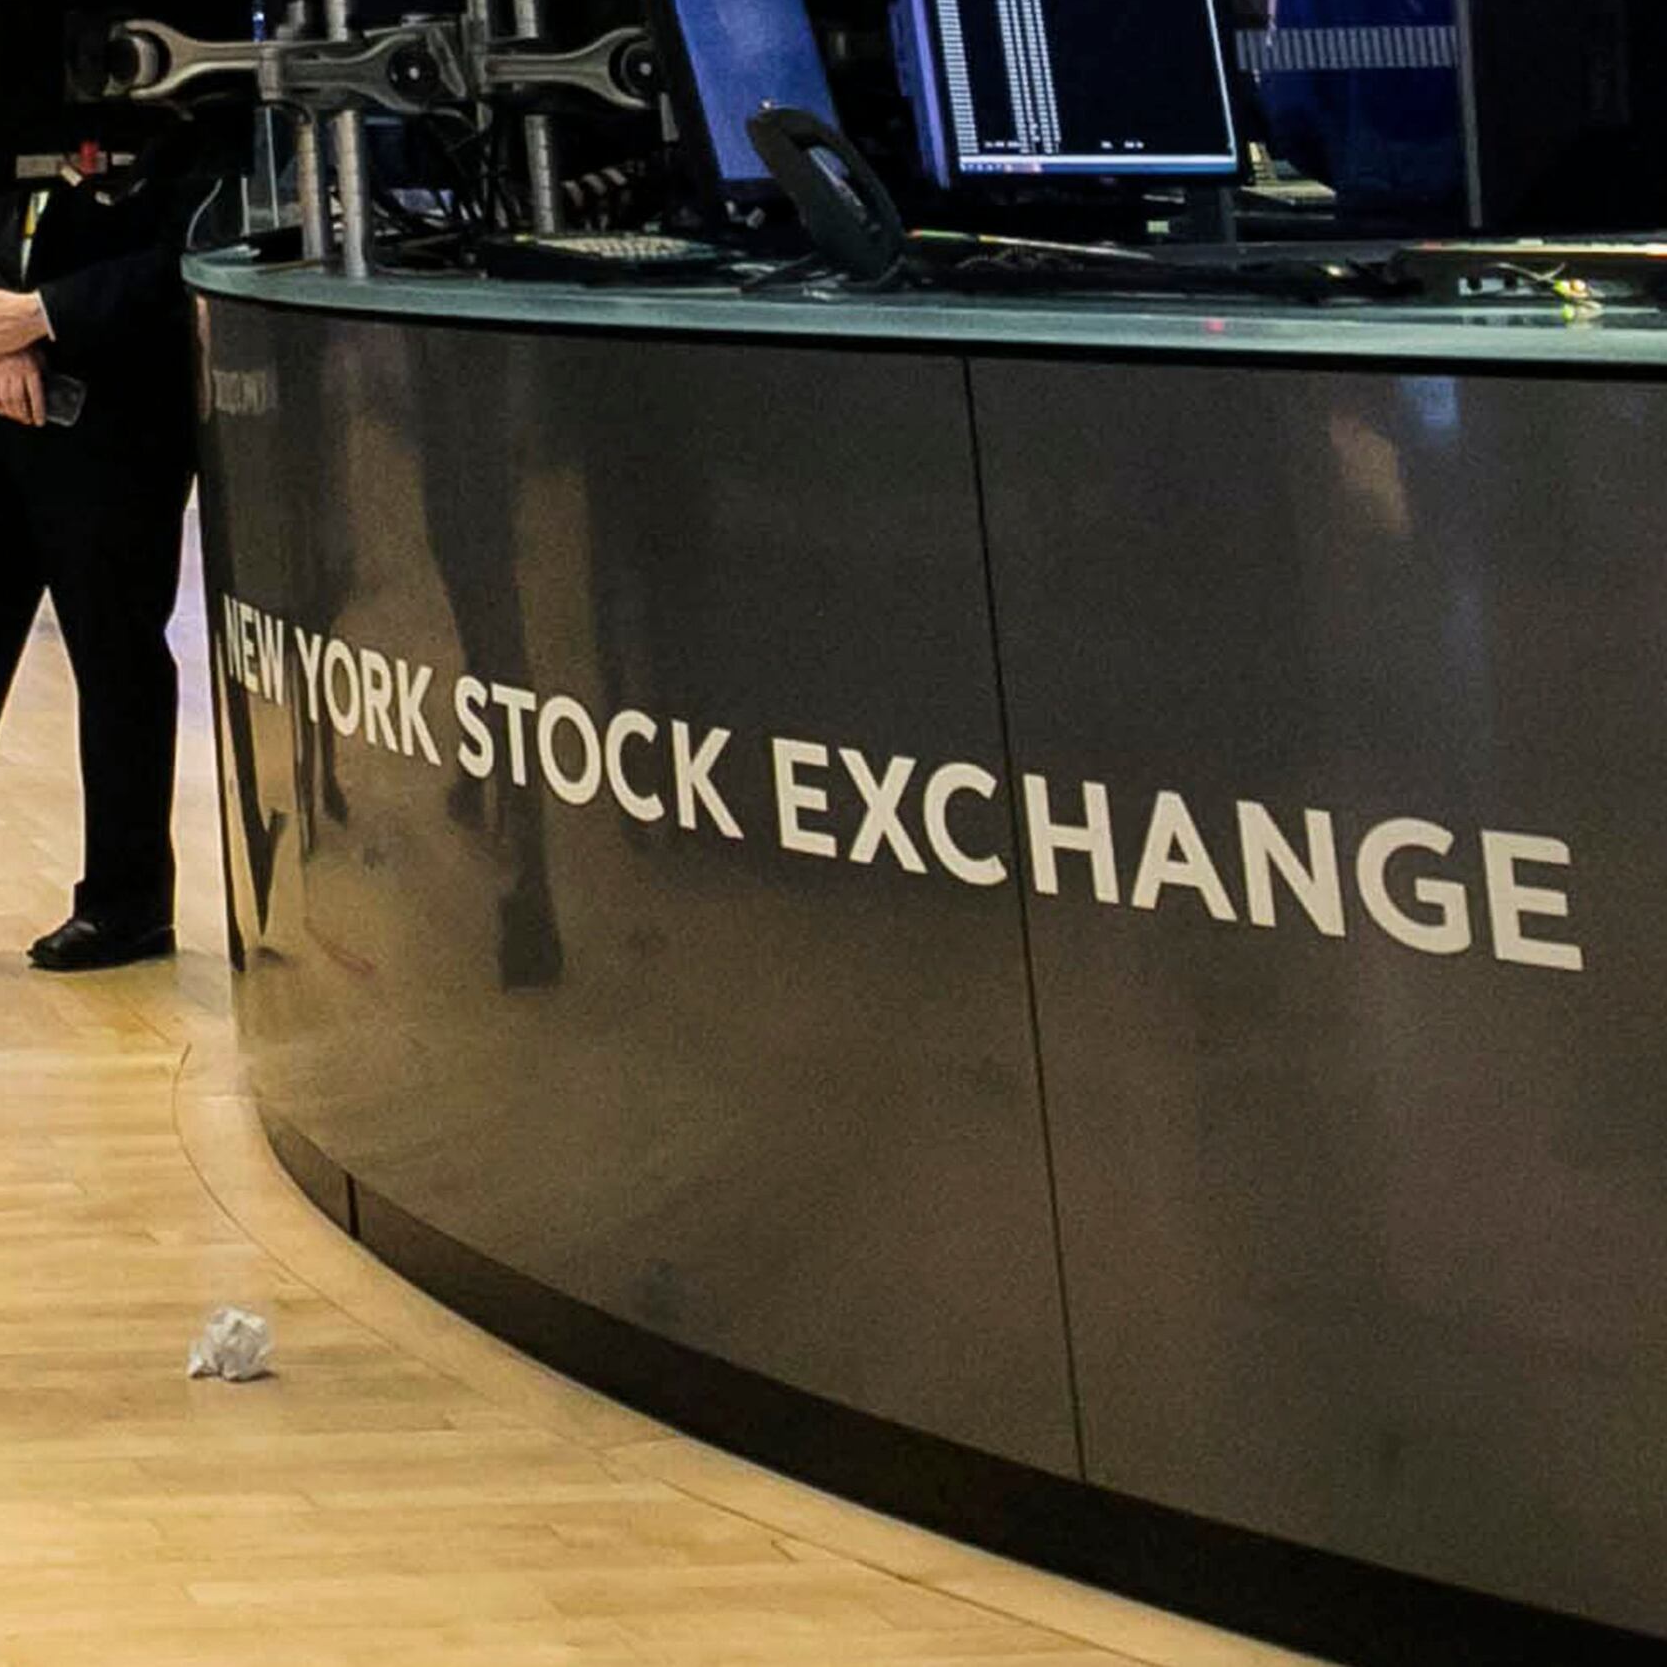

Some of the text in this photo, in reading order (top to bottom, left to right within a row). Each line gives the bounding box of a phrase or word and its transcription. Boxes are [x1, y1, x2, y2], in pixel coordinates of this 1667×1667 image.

[223, 592, 1585, 974] NEW YORK STOCK EXCHANGE
